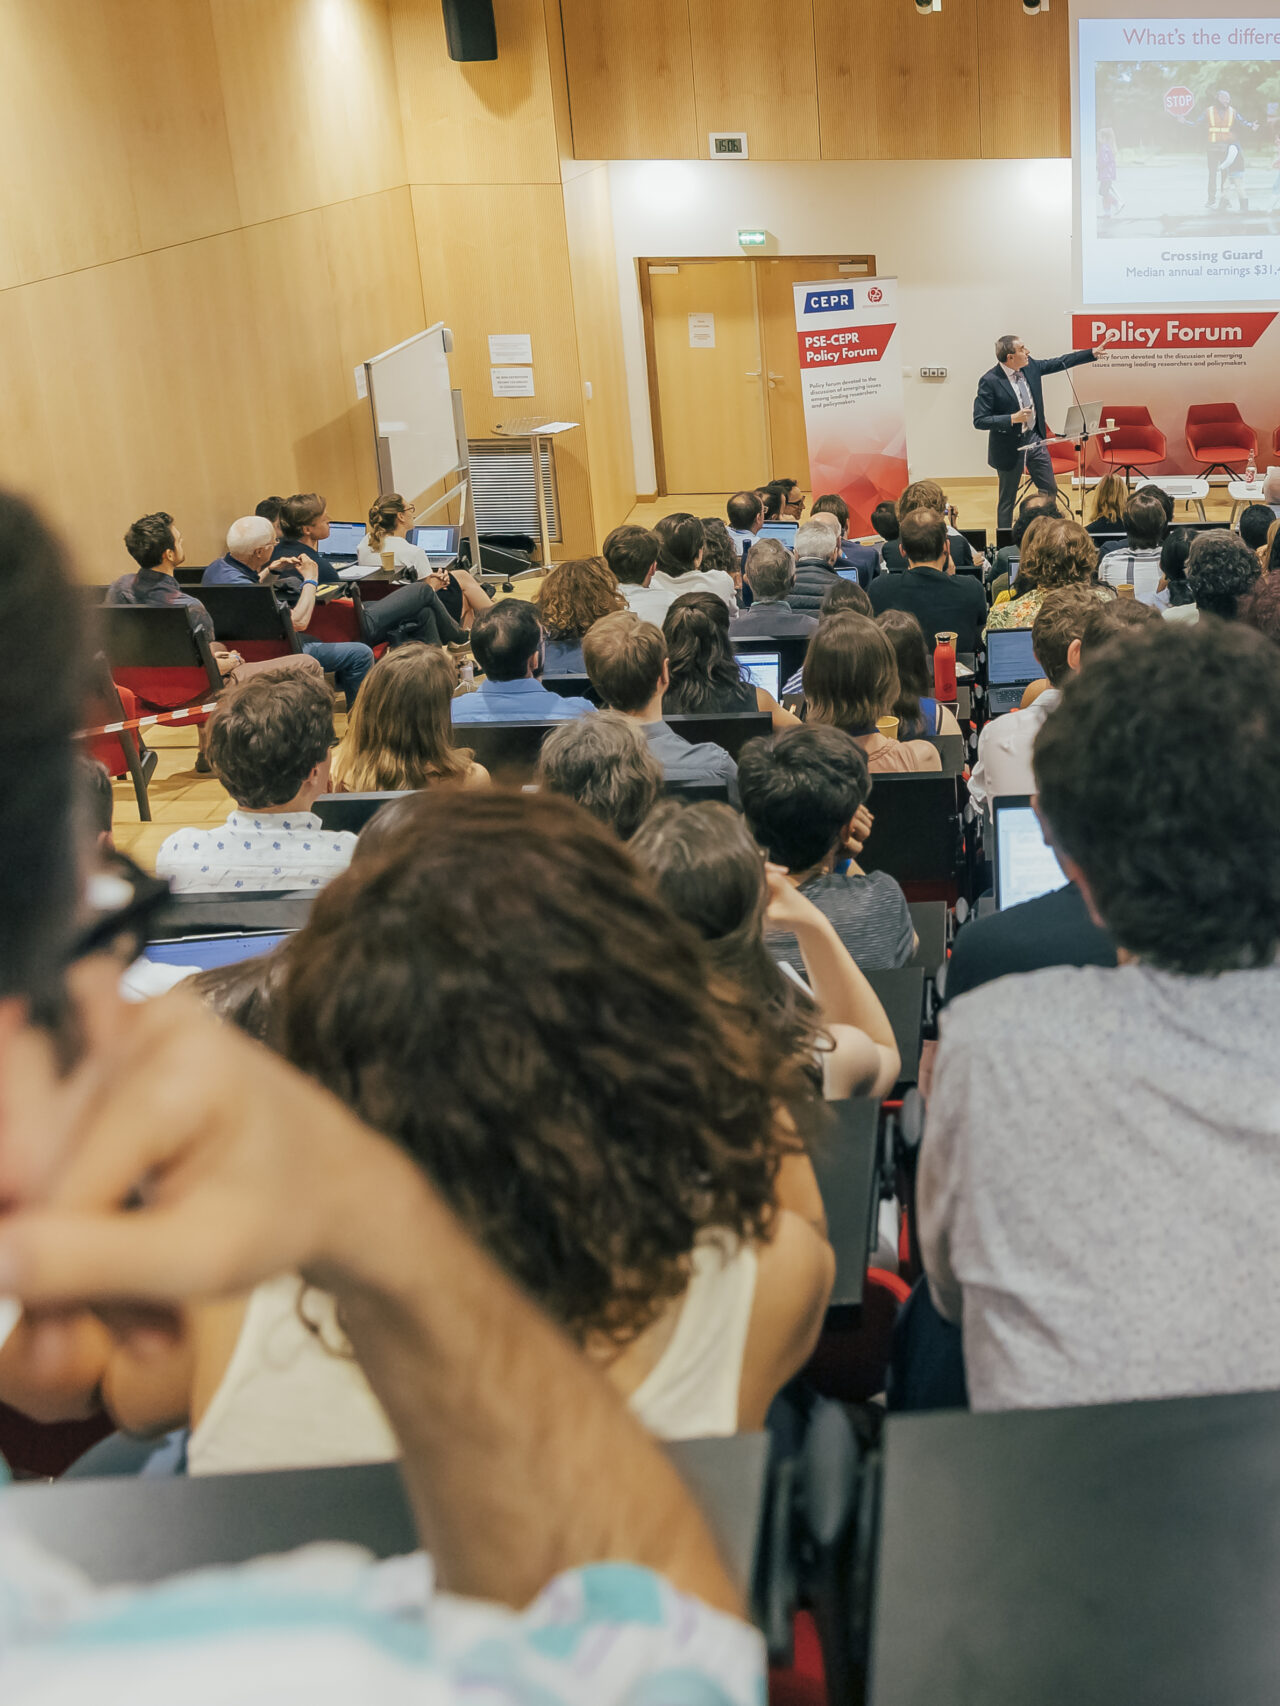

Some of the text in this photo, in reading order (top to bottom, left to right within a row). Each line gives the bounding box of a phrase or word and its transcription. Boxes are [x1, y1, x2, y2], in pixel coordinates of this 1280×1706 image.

[1123, 28, 1186, 45] What's
[1192, 28, 1221, 45] the
[1166, 95, 1193, 107] STOP
[1161, 250, 1264, 263] Crossing Guard
[1126, 266, 1165, 278] Median
[1168, 266, 1203, 277] annual
[1206, 265, 1250, 278] earnings
[810, 294, 849, 308] CEPR
[804, 332, 860, 348] PSE-CEPR
[1091, 320, 1242, 347] Policy Forum
[806, 347, 878, 363] Policy Forum
[843, 384, 866, 392] emerging
[822, 400, 856, 408] policymakers
